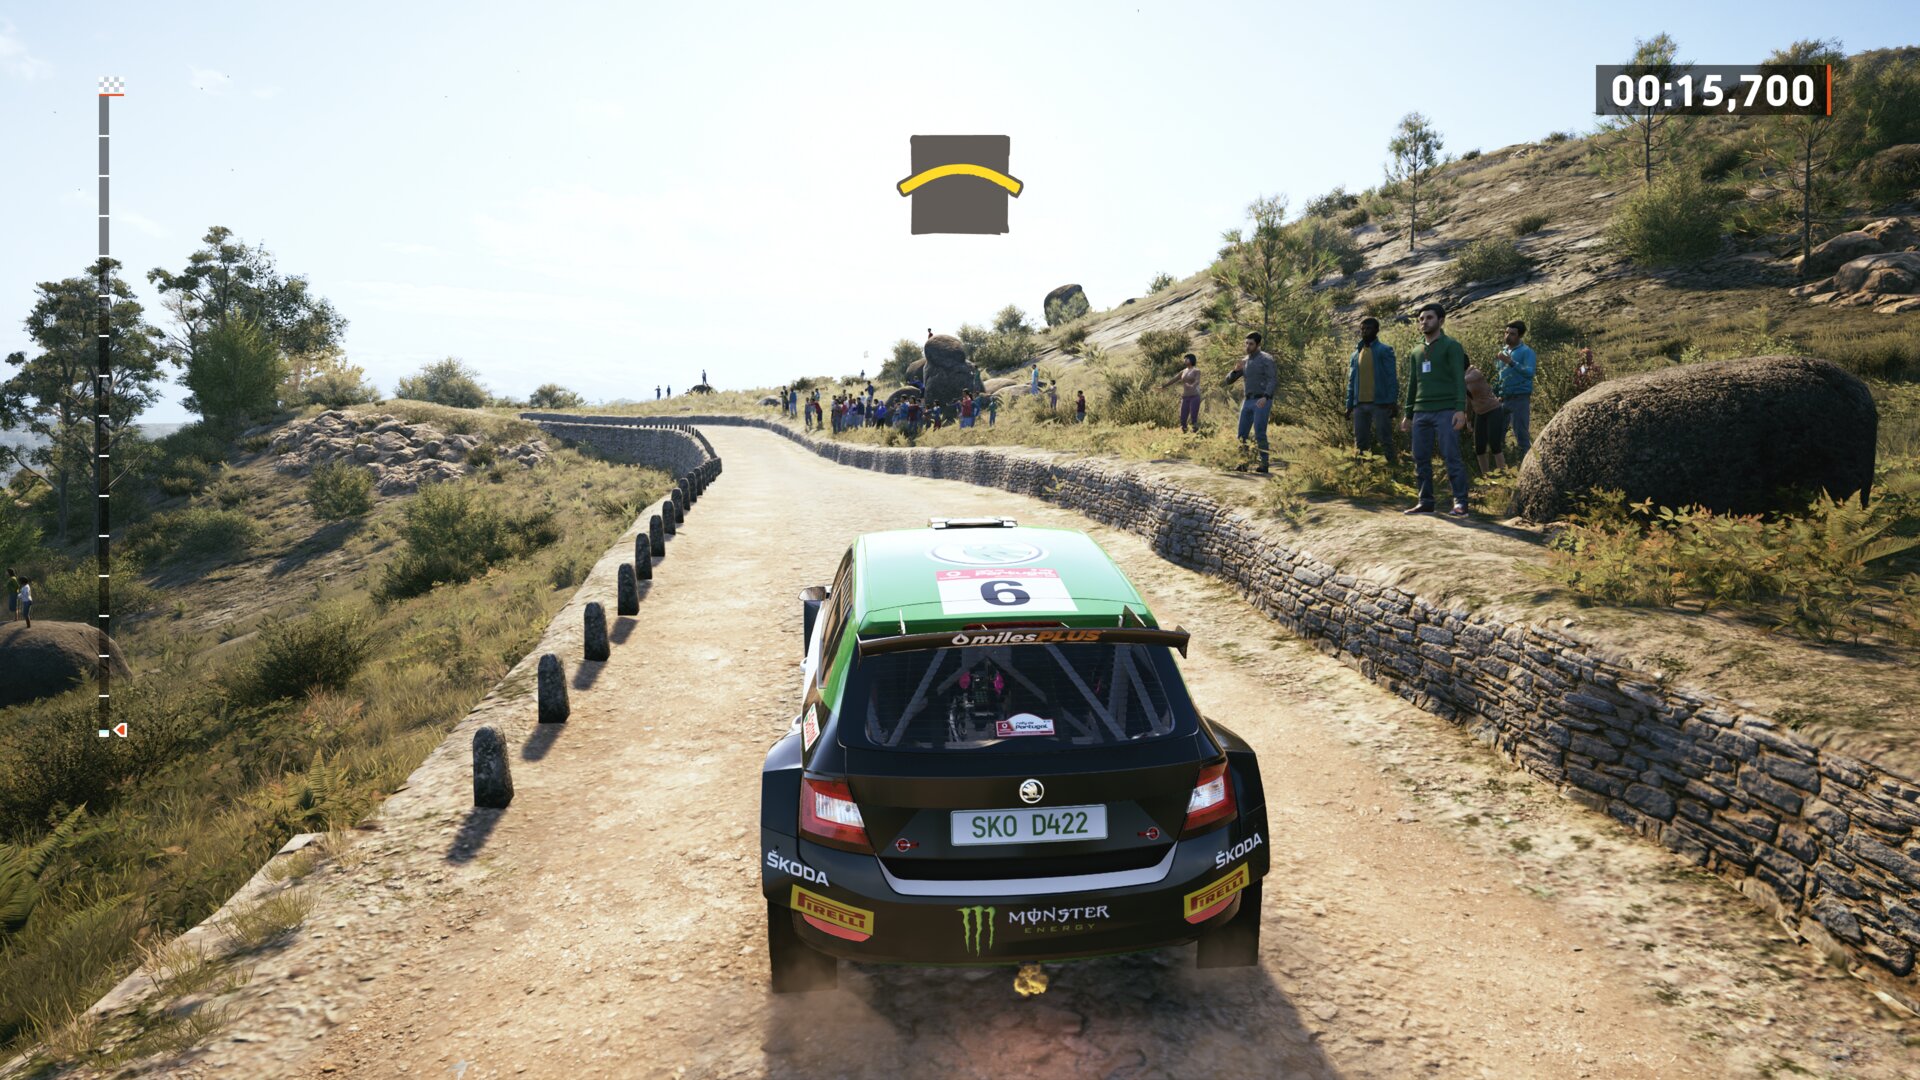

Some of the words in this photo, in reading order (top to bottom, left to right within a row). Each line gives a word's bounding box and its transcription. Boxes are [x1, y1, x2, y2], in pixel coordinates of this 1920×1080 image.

[980, 580, 1031, 606] 6
[972, 815, 1018, 839] SKO
[1032, 812, 1089, 836] D422
[1215, 832, 1263, 870] ŠKODA
[766, 849, 830, 887] ŠKODA
[1190, 869, 1245, 912] PIRELLI
[797, 891, 866, 929] PIRELLI
[1008, 905, 1110, 925] MONSTER
[1024, 923, 1096, 934] ENERGY
